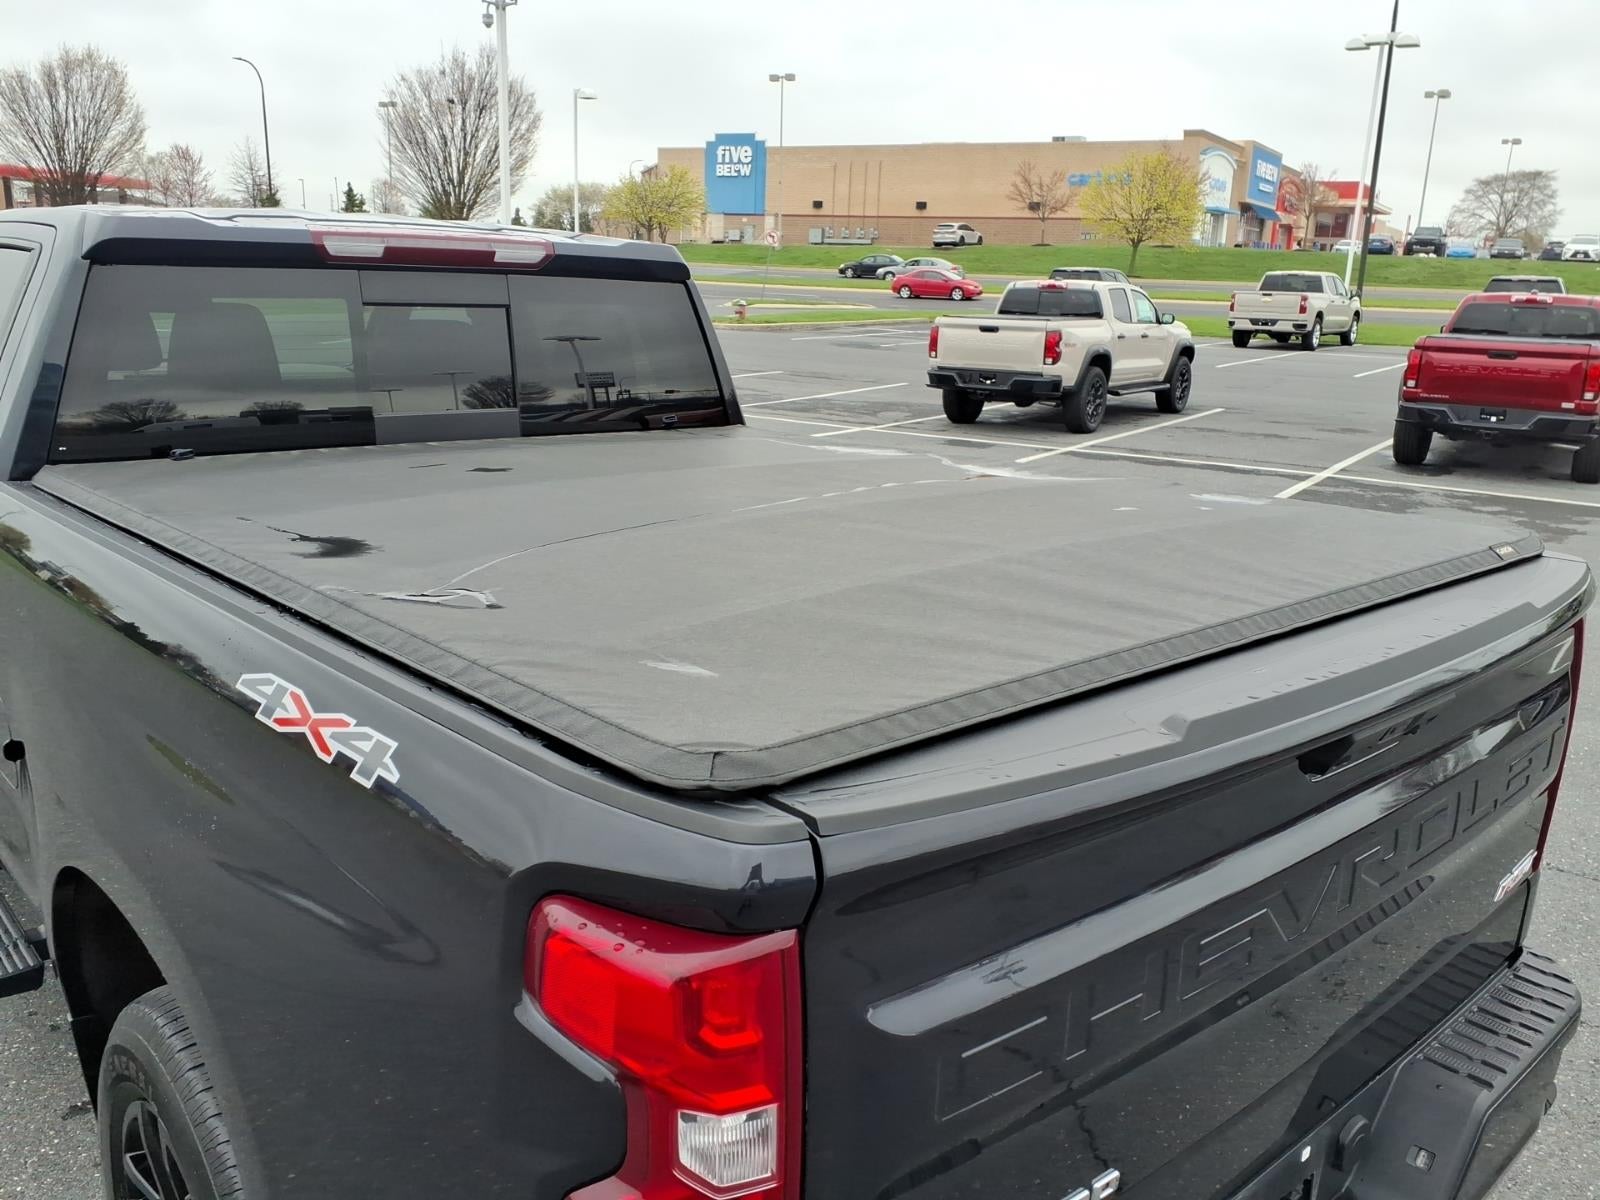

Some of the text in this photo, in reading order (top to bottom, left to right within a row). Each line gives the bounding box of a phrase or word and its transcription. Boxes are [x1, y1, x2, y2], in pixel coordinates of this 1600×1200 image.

[716, 145, 753, 164] five
[715, 164, 752, 177] BELOW
[934, 715, 1566, 1123] CHEVROLET
